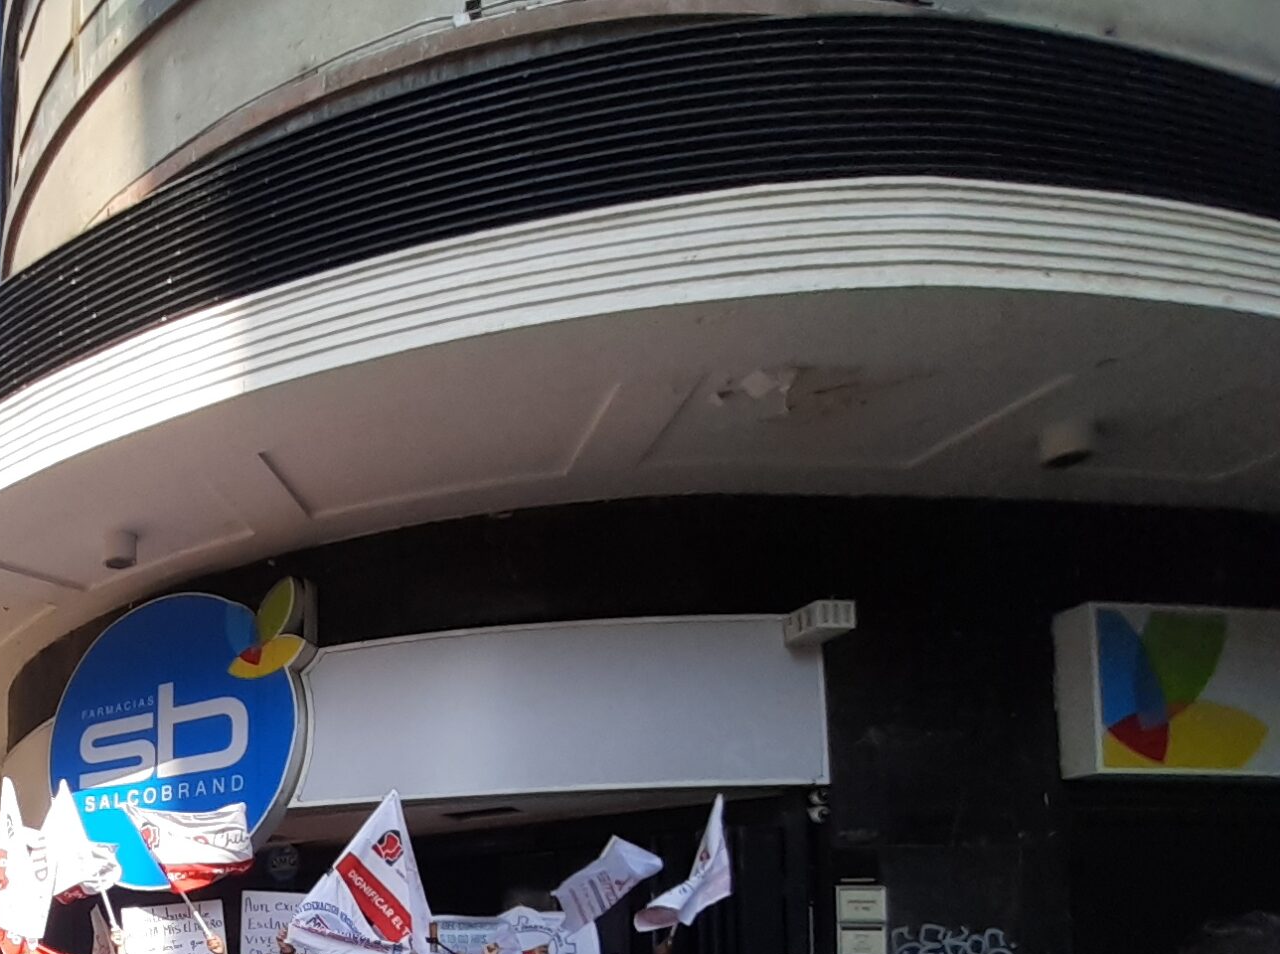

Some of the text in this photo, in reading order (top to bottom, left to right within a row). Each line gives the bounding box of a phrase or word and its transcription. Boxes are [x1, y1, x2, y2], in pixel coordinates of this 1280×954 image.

[81, 695, 155, 720] FARMACIAS
[79, 682, 249, 790] sb
[83, 774, 245, 813] SALCOBRAND
[348, 868, 405, 931] DIGNIFICAR EL
